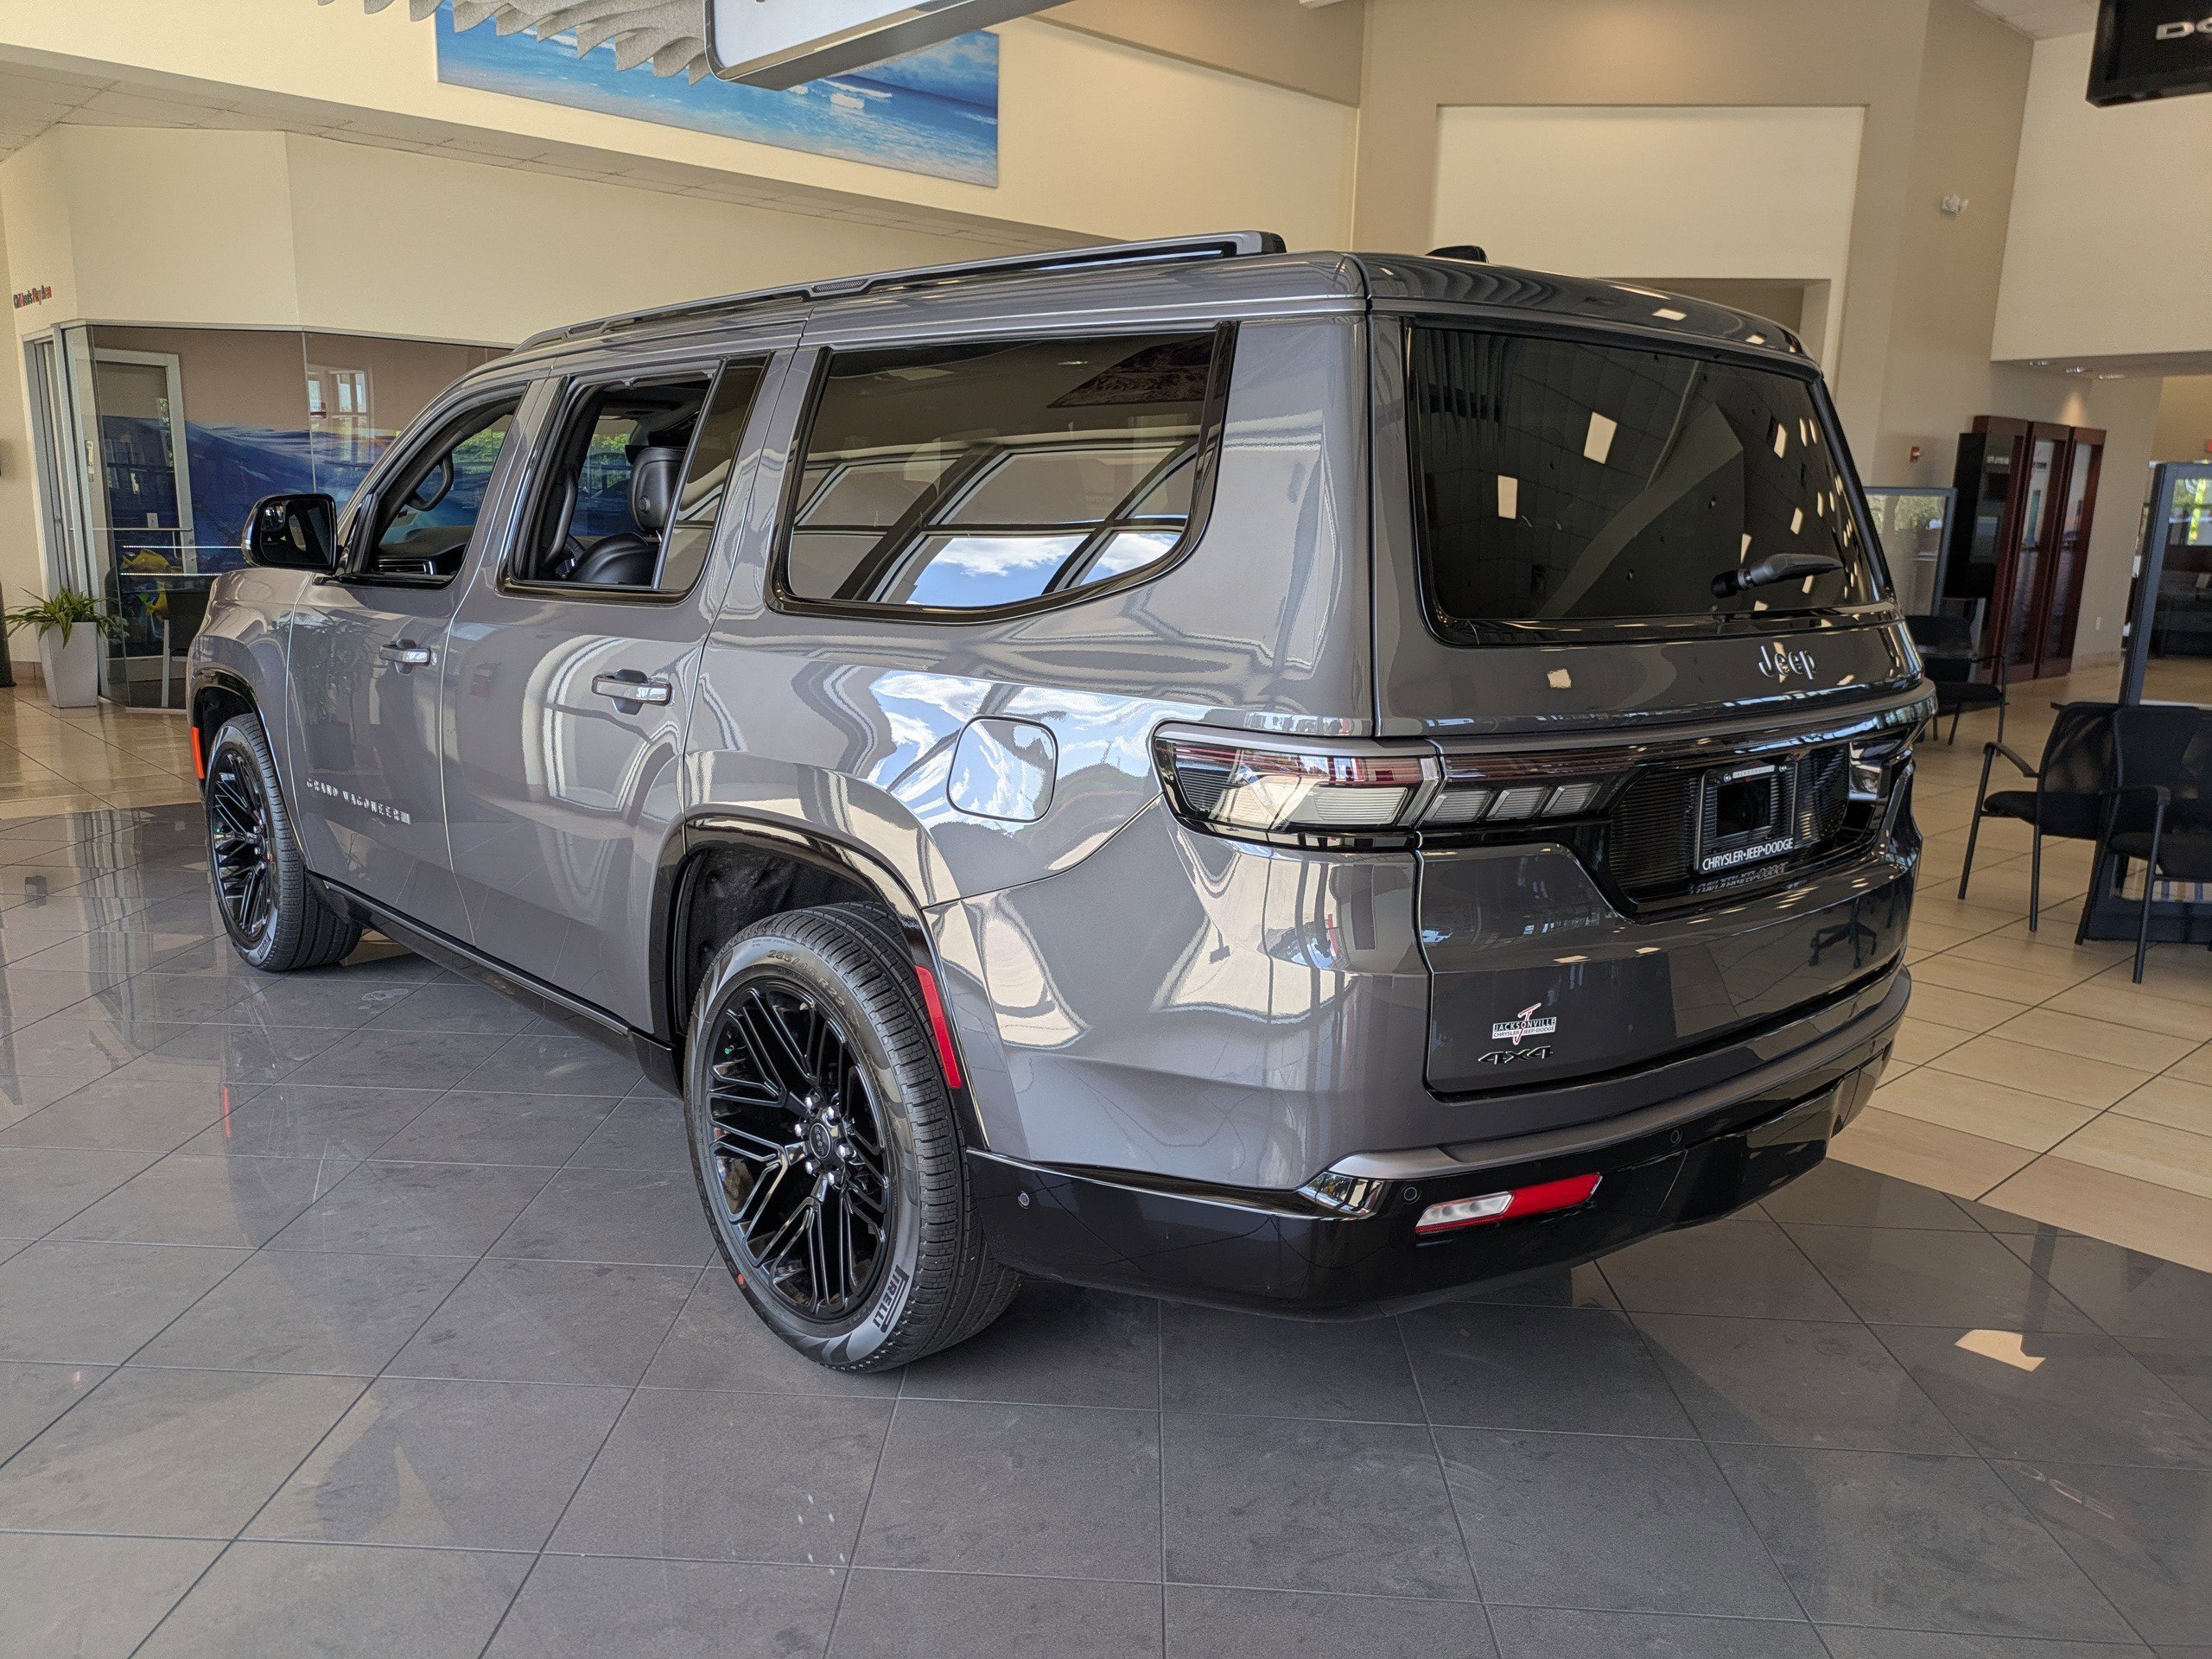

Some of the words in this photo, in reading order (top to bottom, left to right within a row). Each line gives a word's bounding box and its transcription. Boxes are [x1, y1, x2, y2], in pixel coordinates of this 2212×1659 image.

[1758, 645, 1818, 680] Jeep
[307, 778, 339, 797] GRAND
[342, 791, 400, 822] WAGONEER
[1494, 1019, 1555, 1032] JACKSONVILLE
[873, 1264, 910, 1333] PIRELLI
